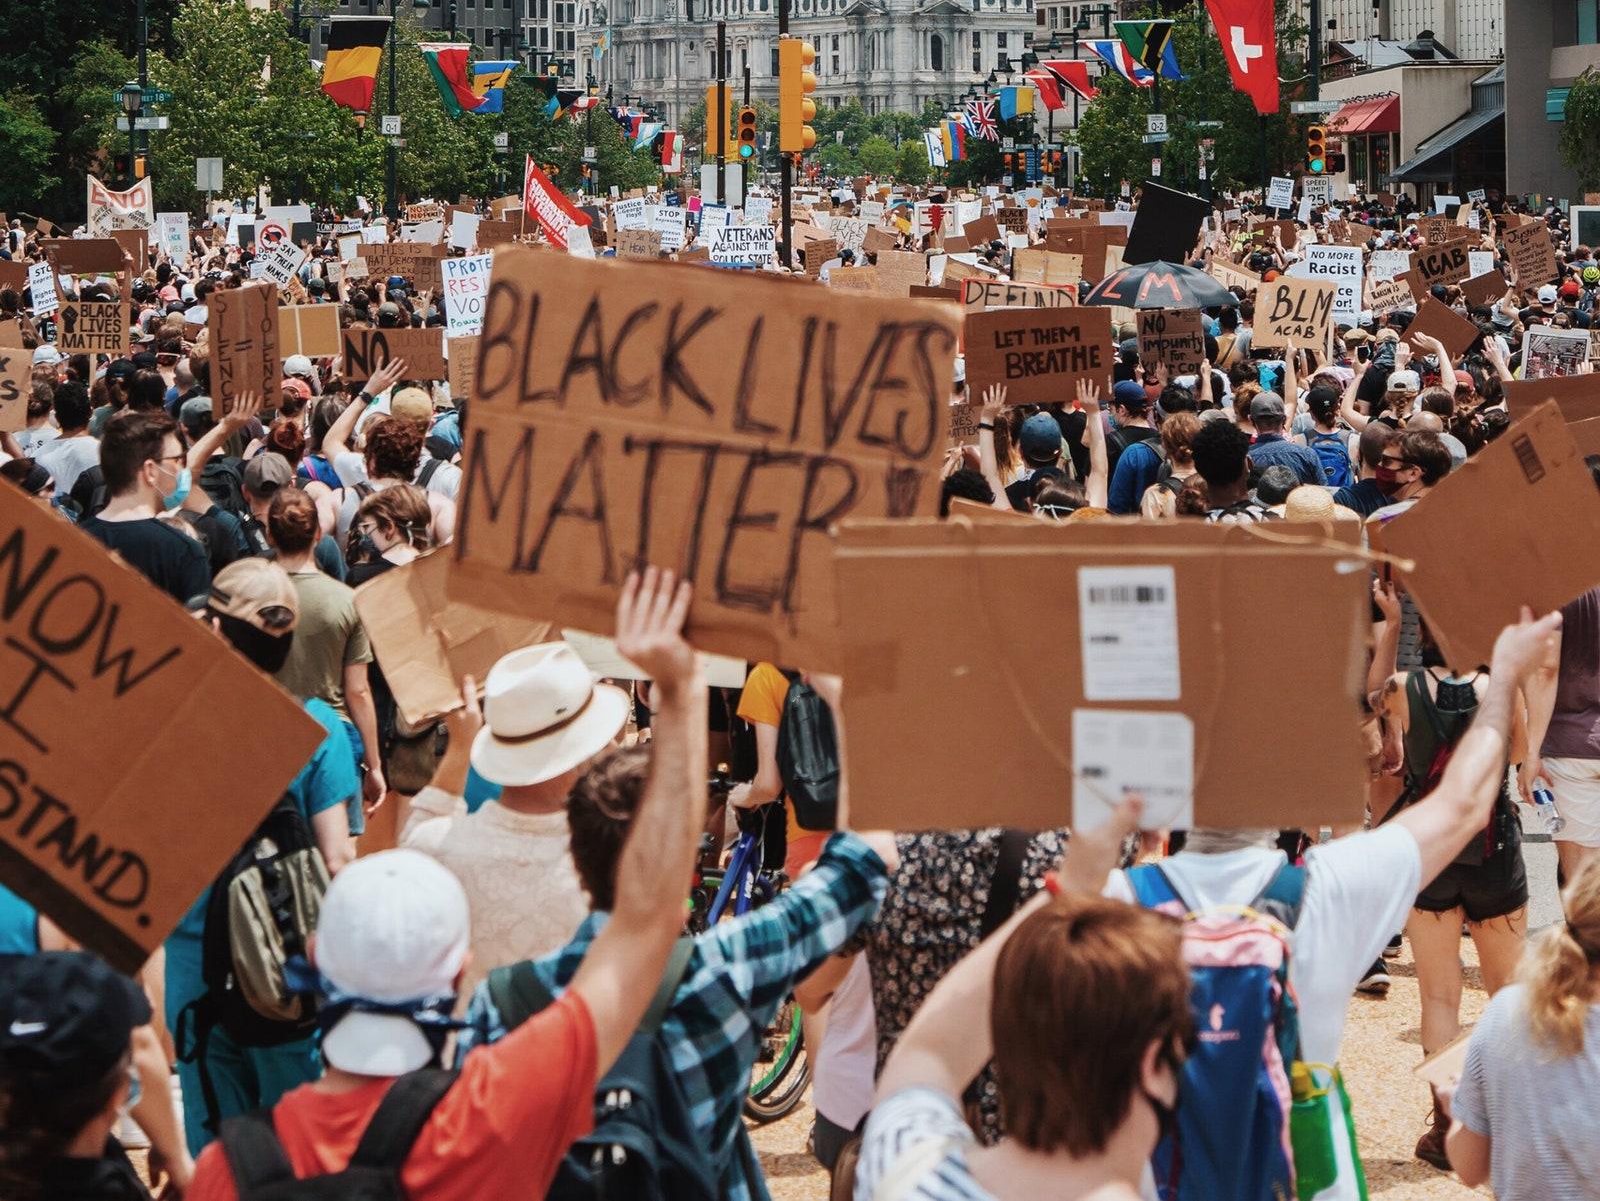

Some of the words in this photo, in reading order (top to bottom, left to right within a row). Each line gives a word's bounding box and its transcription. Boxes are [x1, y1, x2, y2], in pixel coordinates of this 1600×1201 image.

[1151, 122, 1164, 131] Q-2
[91, 184, 146, 208] END
[1308, 194, 1326, 206] 25
[616, 201, 642, 211] Justice
[999, 208, 1024, 217] BLACK
[717, 228, 774, 242] VETERANS
[830, 219, 866, 234] BLACK
[280, 244, 296, 258] SAY
[372, 244, 405, 255] THIS
[409, 245, 421, 254] IS
[712, 241, 750, 252] AGAINST
[754, 242, 768, 250] THE
[1328, 252, 1354, 260] MORE
[274, 253, 294, 272] THEIR
[448, 252, 492, 278] PROTE
[712, 254, 744, 264] POLICE
[748, 254, 772, 264] STATE
[1309, 262, 1356, 275] Racist
[1417, 248, 1467, 280] ACAB
[35, 265, 52, 277] STO
[265, 264, 288, 284] NAMES
[448, 276, 490, 297] RESI
[966, 280, 1074, 308] DEFUND
[80, 304, 121, 318] BLACK
[456, 294, 489, 316] VOT
[1269, 285, 1334, 328] BLM
[80, 319, 121, 333] LIVES
[1142, 315, 1166, 334] NO
[1274, 325, 1315, 338] ACAB
[61, 334, 121, 349] MATTER
[259, 285, 275, 409] VIOLENCE
[994, 330, 1026, 349] LET
[1031, 326, 1080, 345] THEM
[1143, 331, 1203, 355] impunity
[214, 294, 234, 415] SILENCE
[345, 330, 390, 377] NO
[1005, 345, 1102, 379] BREATHE
[475, 279, 722, 416] BLACK
[733, 313, 957, 461] LIVES
[0, 527, 183, 699] NOW
[0, 635, 77, 755] I
[0, 758, 152, 929] STAND.
